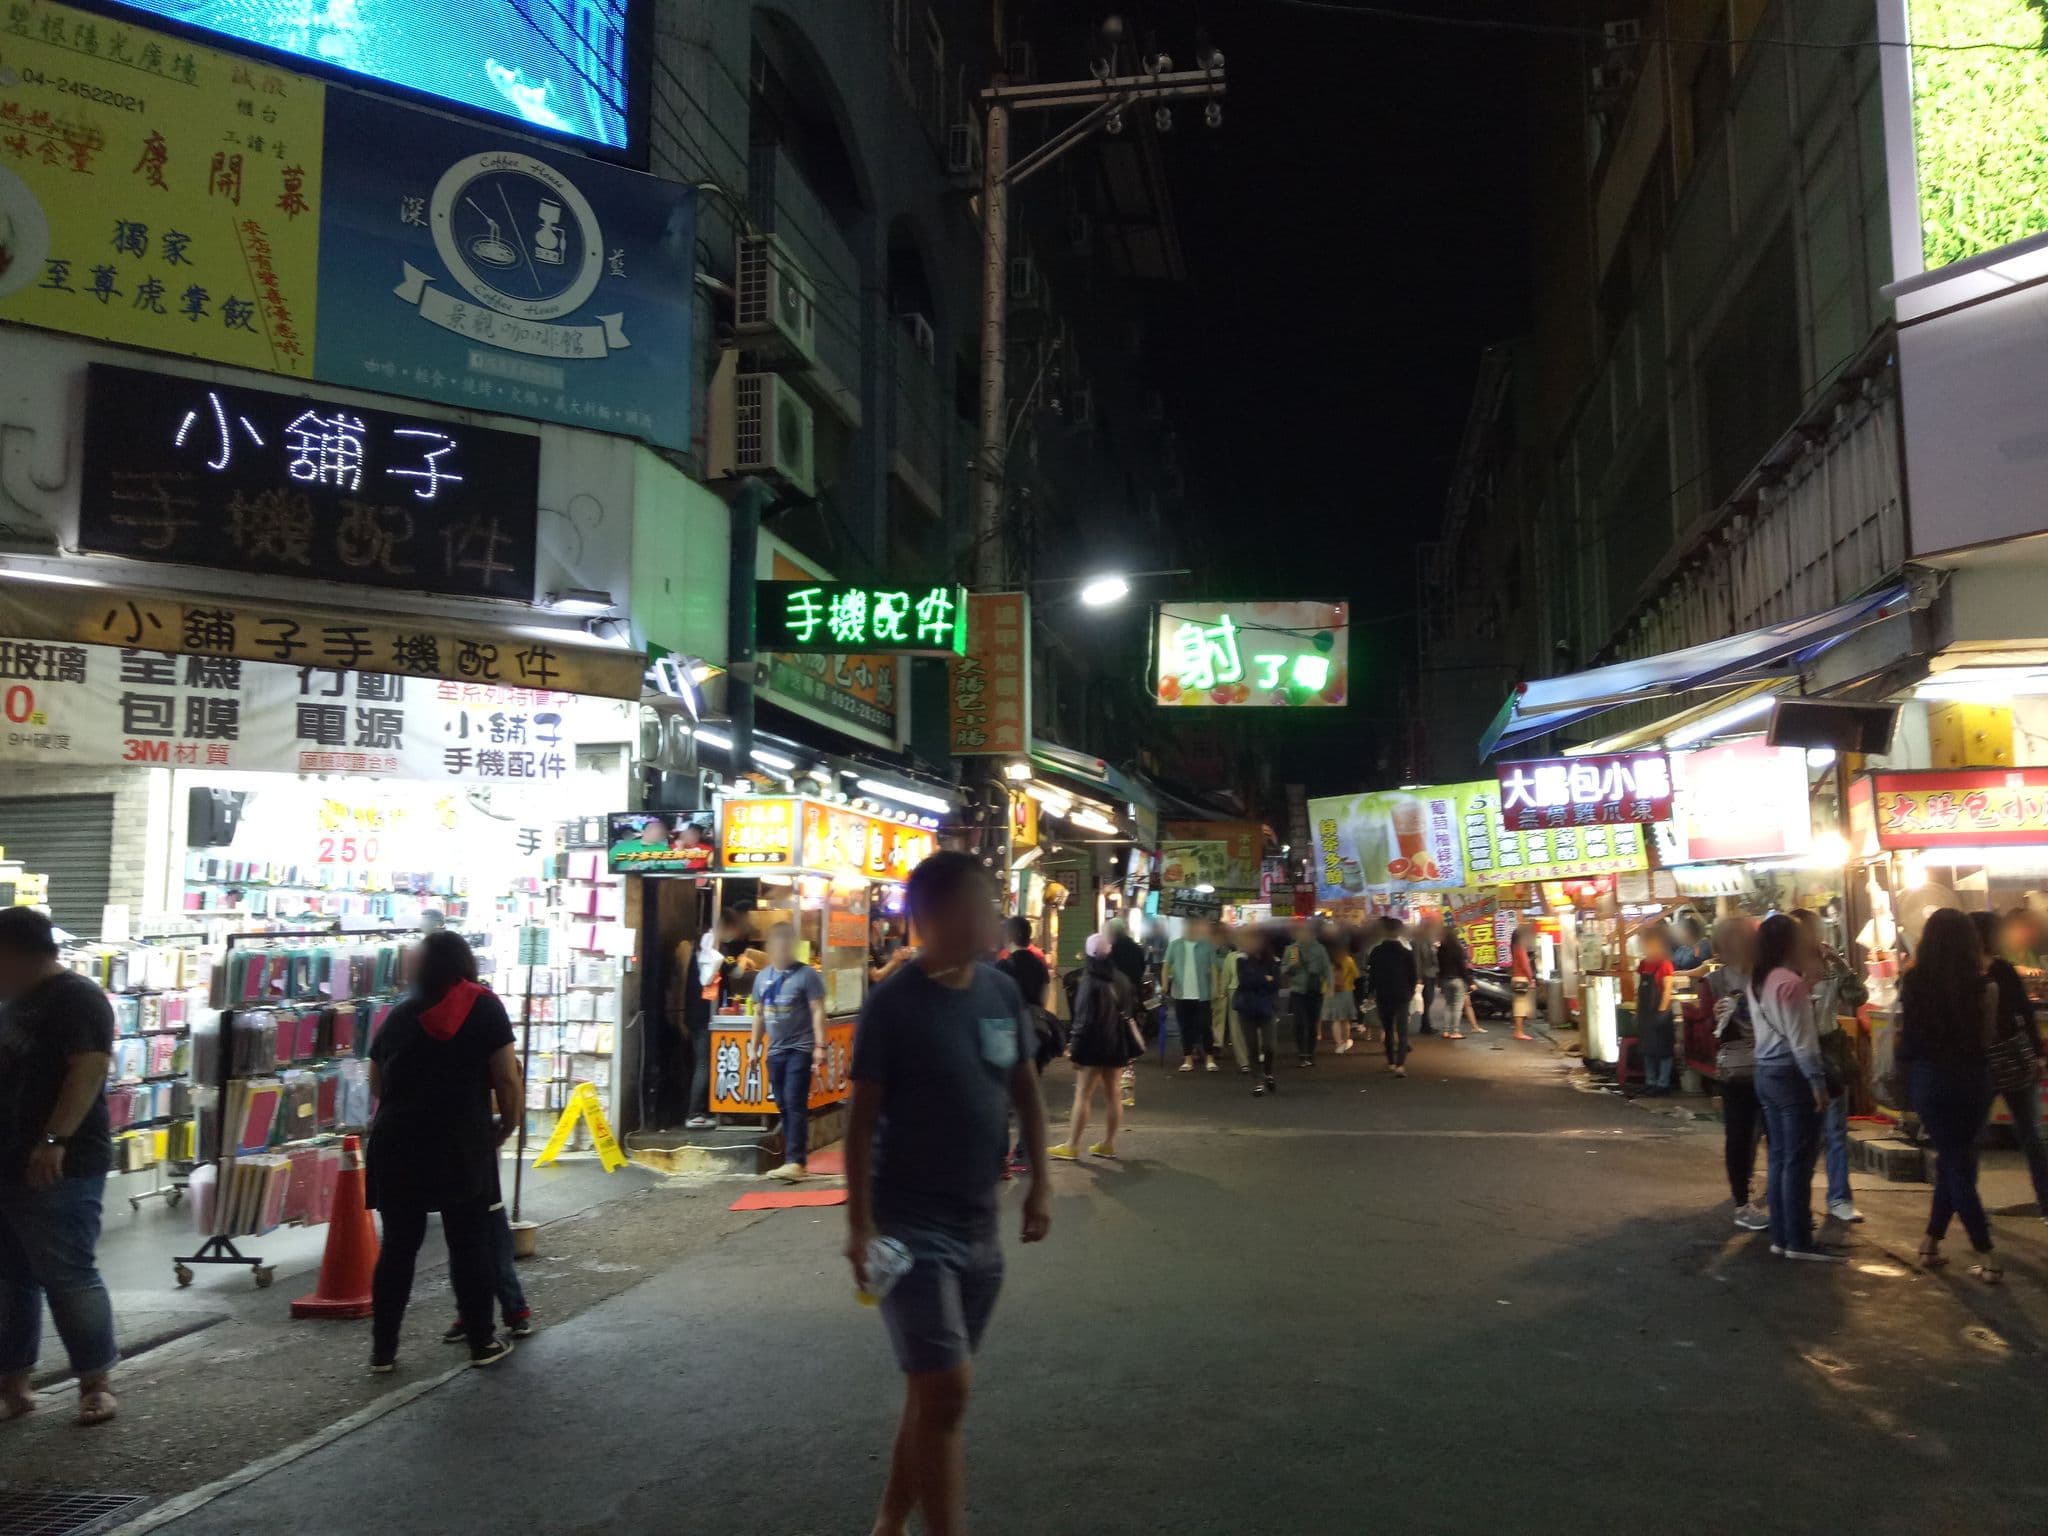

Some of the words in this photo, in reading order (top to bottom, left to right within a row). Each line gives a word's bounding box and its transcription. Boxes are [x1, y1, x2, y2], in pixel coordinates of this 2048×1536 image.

[23, 68, 145, 113] 04-24522021
[112, 218, 193, 266] 獨家
[38, 258, 259, 334] 至尊虎掌飯
[110, 470, 515, 588] 手機配件
[785, 587, 954, 644] 手機配件
[0, 640, 88, 684] 玻璃
[120, 648, 241, 690] 全機
[296, 665, 404, 703] 行動
[118, 690, 240, 742] 包膜
[296, 702, 405, 750] 電源
[953, 657, 988, 747] 大腸包小腸
[8, 732, 72, 751] 9H硬度
[443, 747, 568, 780] 手機配件
[1502, 757, 1670, 809] 大腸包小腸
[317, 837, 380, 863] 250
